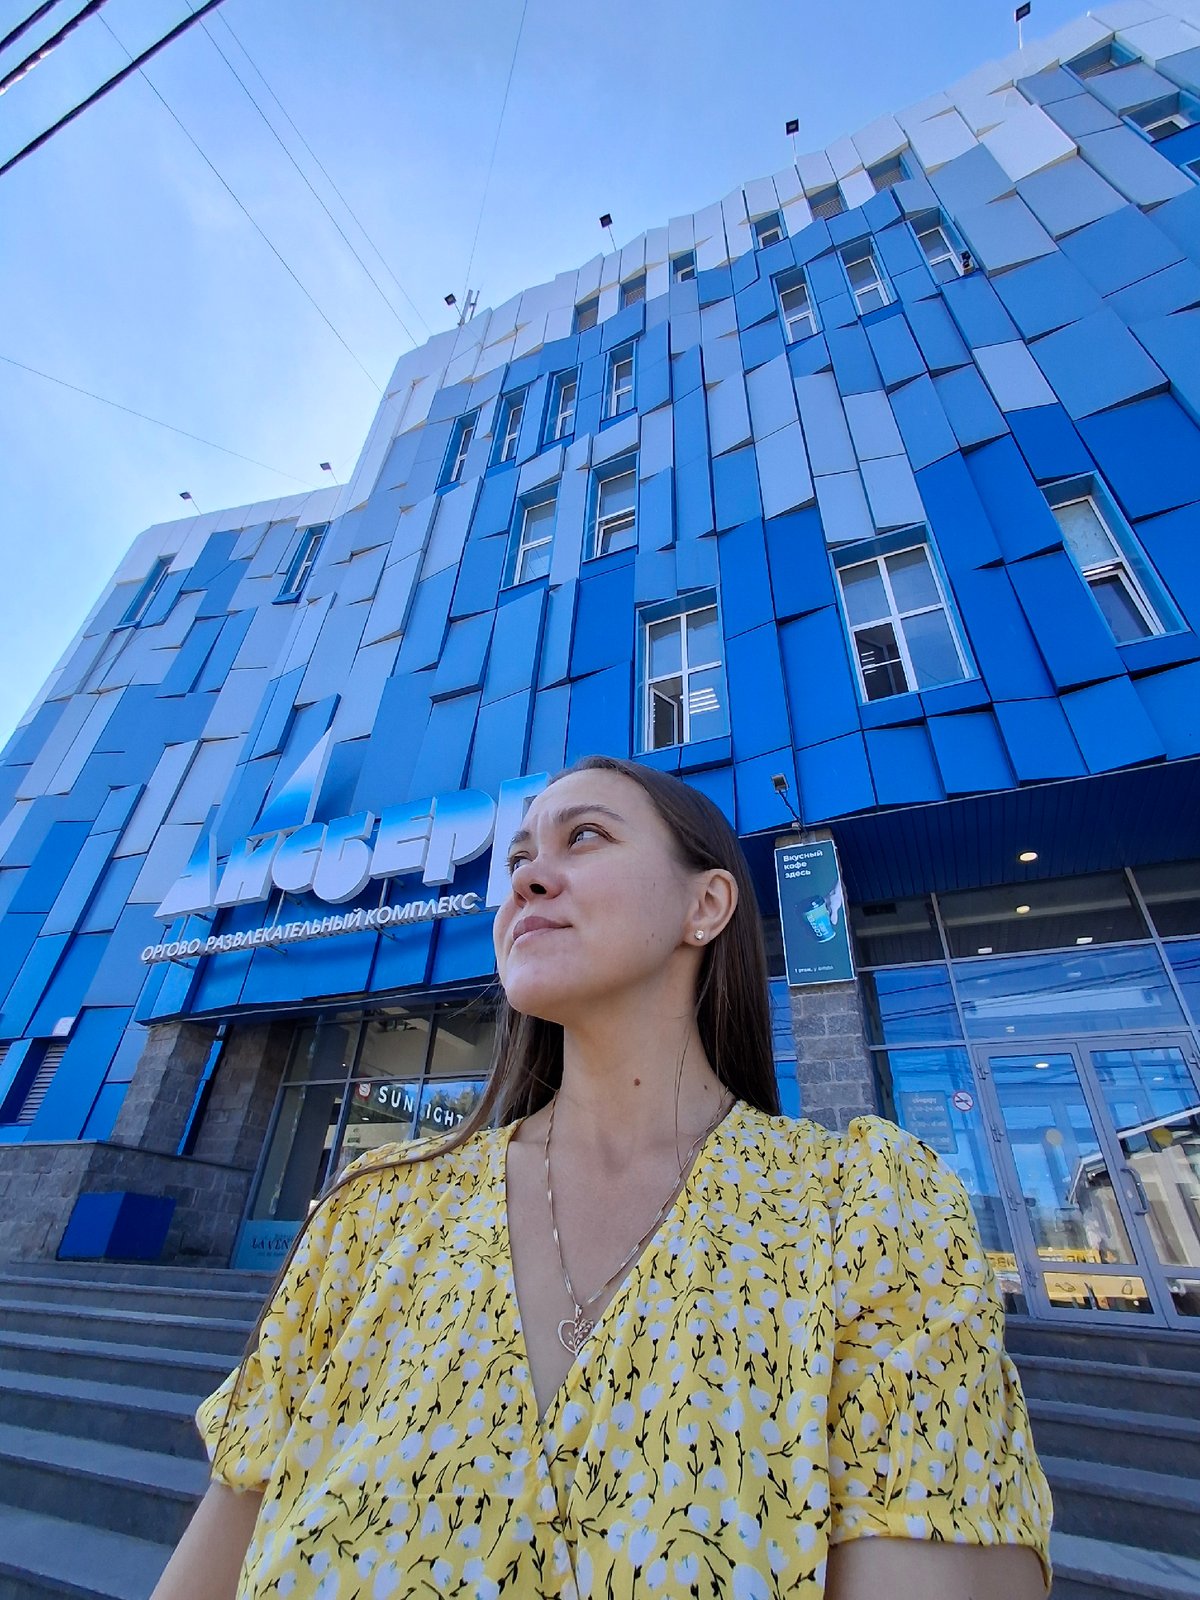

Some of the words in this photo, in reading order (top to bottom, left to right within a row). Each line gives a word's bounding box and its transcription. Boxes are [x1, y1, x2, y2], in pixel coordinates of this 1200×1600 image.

[783, 849, 823, 862] Вкусный
[784, 861, 807, 871] кофе
[785, 869, 811, 879] здесь
[141, 937, 201, 963] ОРГОВО
[204, 907, 362, 953] РАЗВЛЕКАТЕЛЬНЫЙ
[364, 892, 479, 926] КОМПЛЕКС
[378, 1085, 464, 1127] SUNIGHT
